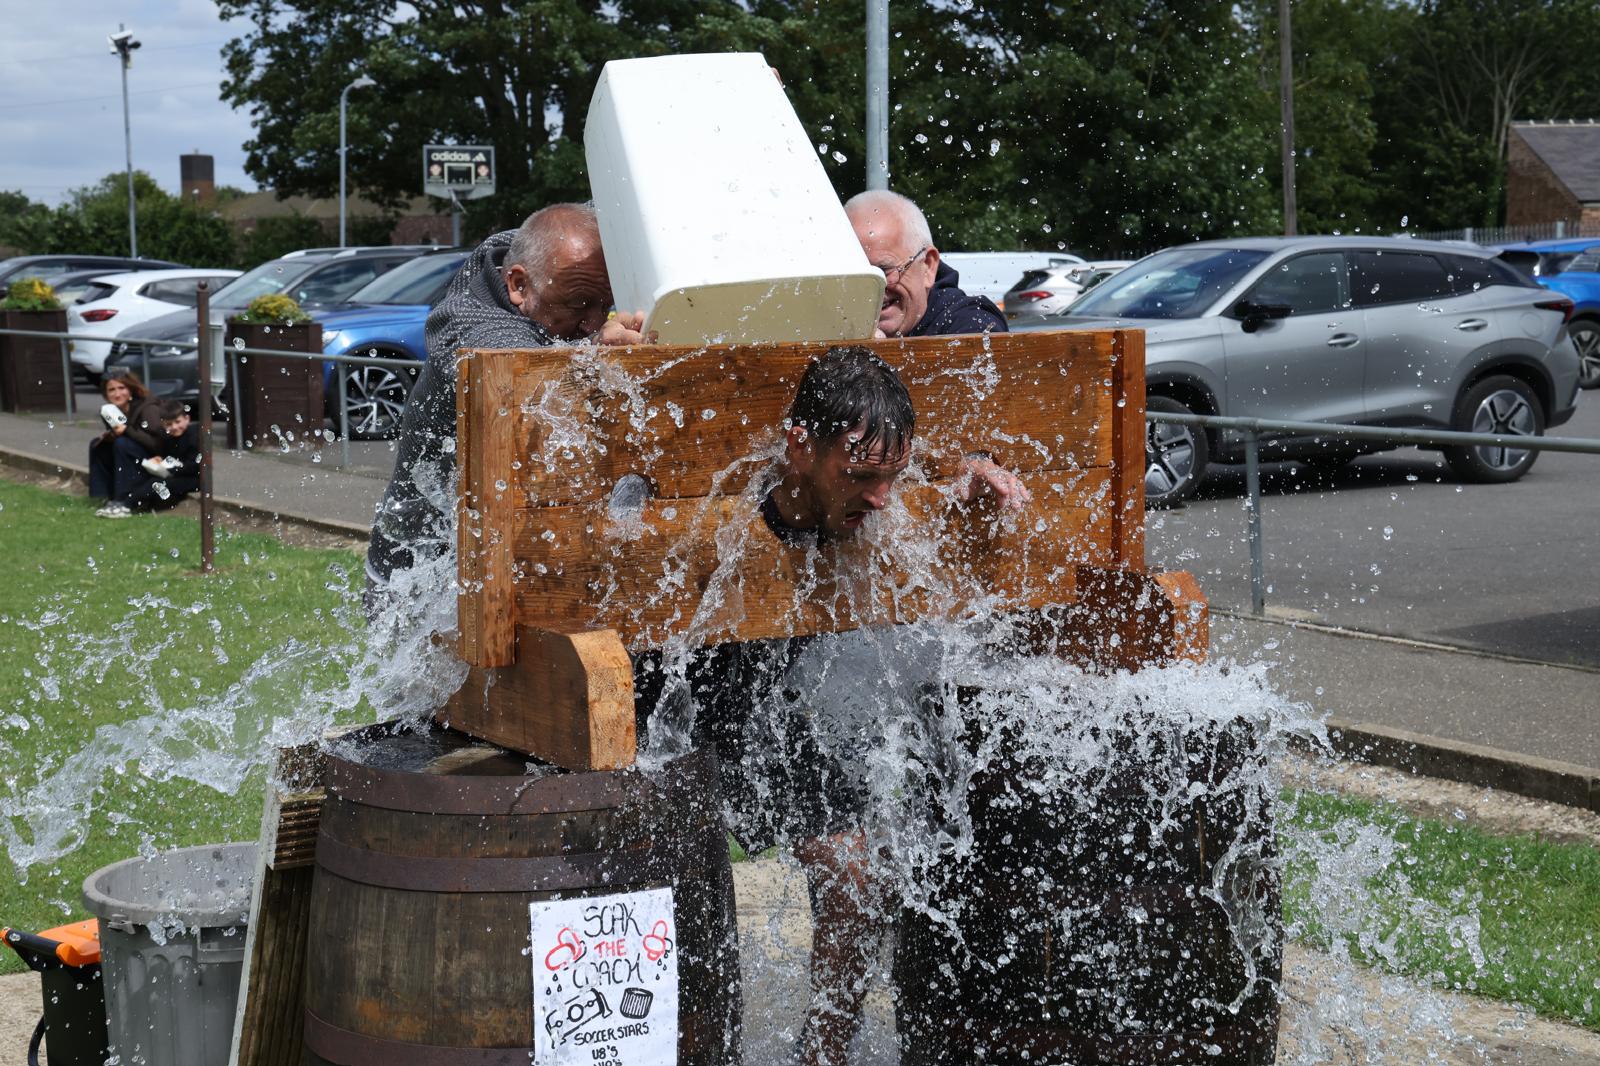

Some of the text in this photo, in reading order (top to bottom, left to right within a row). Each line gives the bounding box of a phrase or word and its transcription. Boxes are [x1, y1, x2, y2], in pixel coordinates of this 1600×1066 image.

[584, 902, 642, 938] SOAK
[594, 938, 627, 958] THE
[574, 1021, 649, 1046] SOCCER STARS
